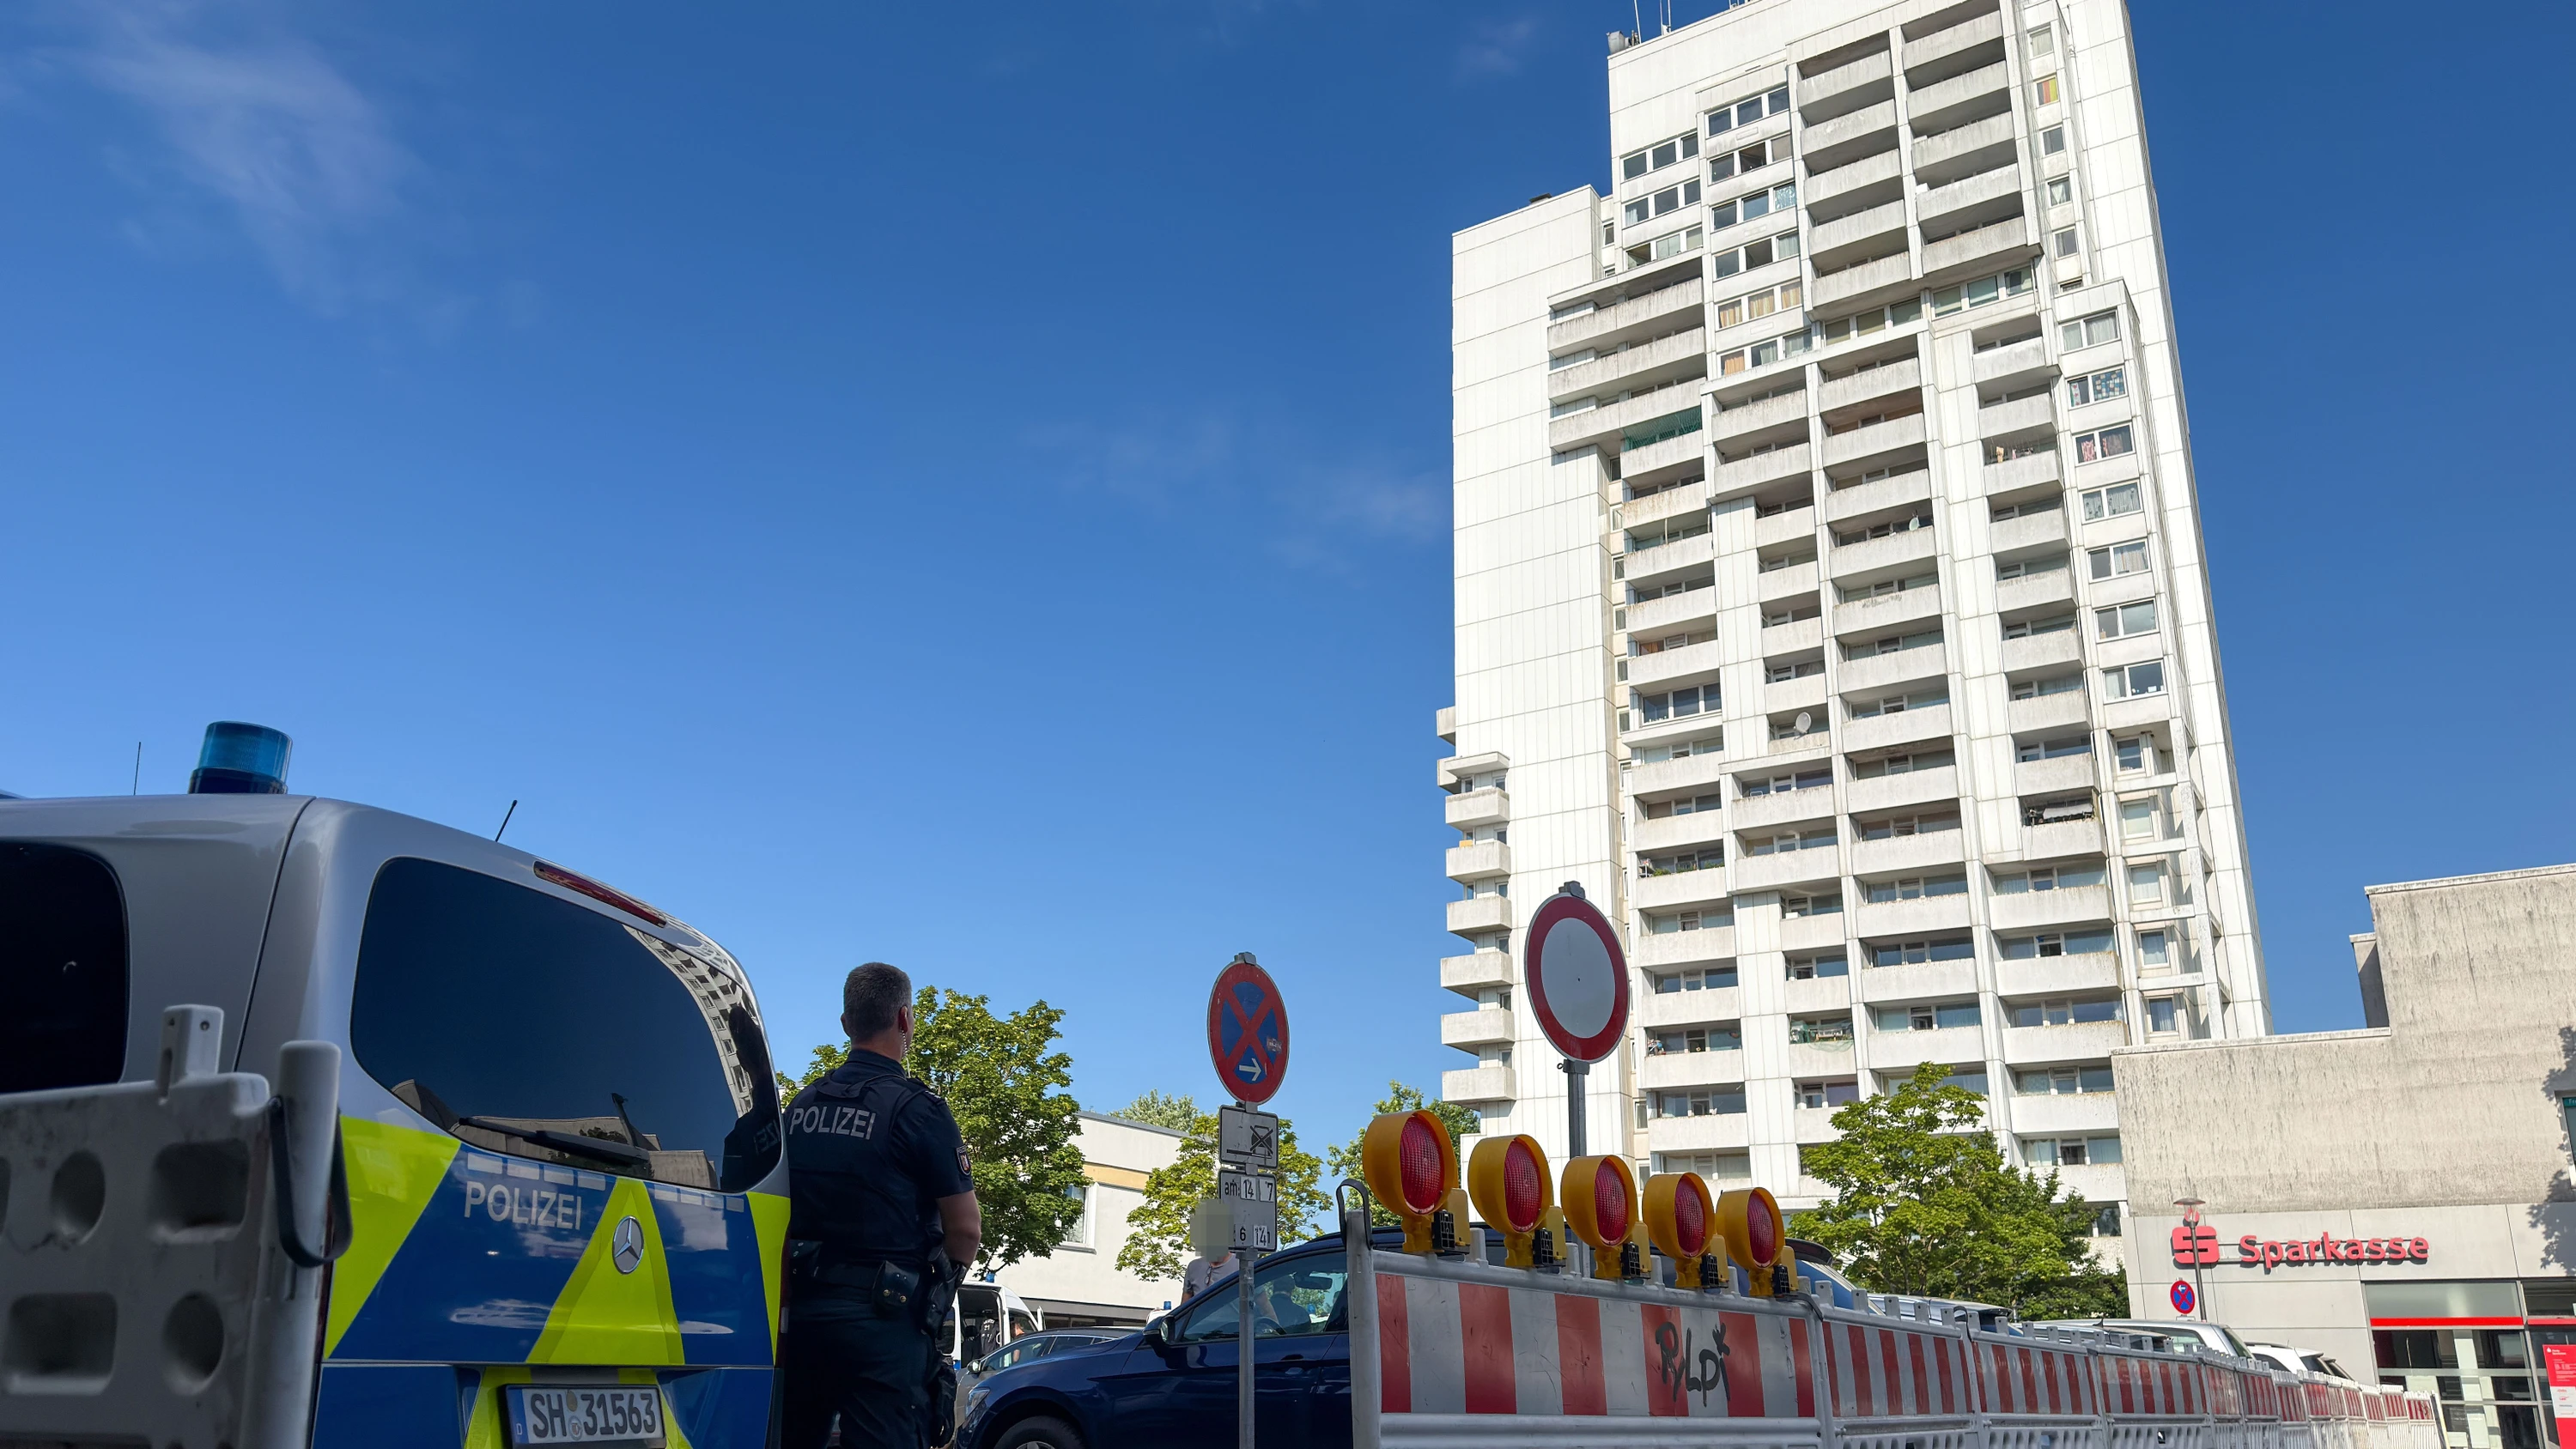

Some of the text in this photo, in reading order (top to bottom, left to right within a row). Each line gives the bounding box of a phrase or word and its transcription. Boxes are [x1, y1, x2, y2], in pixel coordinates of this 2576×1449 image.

[789, 1106, 877, 1140] POLIZEI
[464, 1180, 582, 1230] POLIZEI
[1243, 1179, 1255, 1198] 14
[1239, 1226, 1247, 1241] 6
[2239, 1231, 2429, 1269] Sparkasse
[530, 1393, 567, 1439] SH
[581, 1393, 656, 1436] 31563
